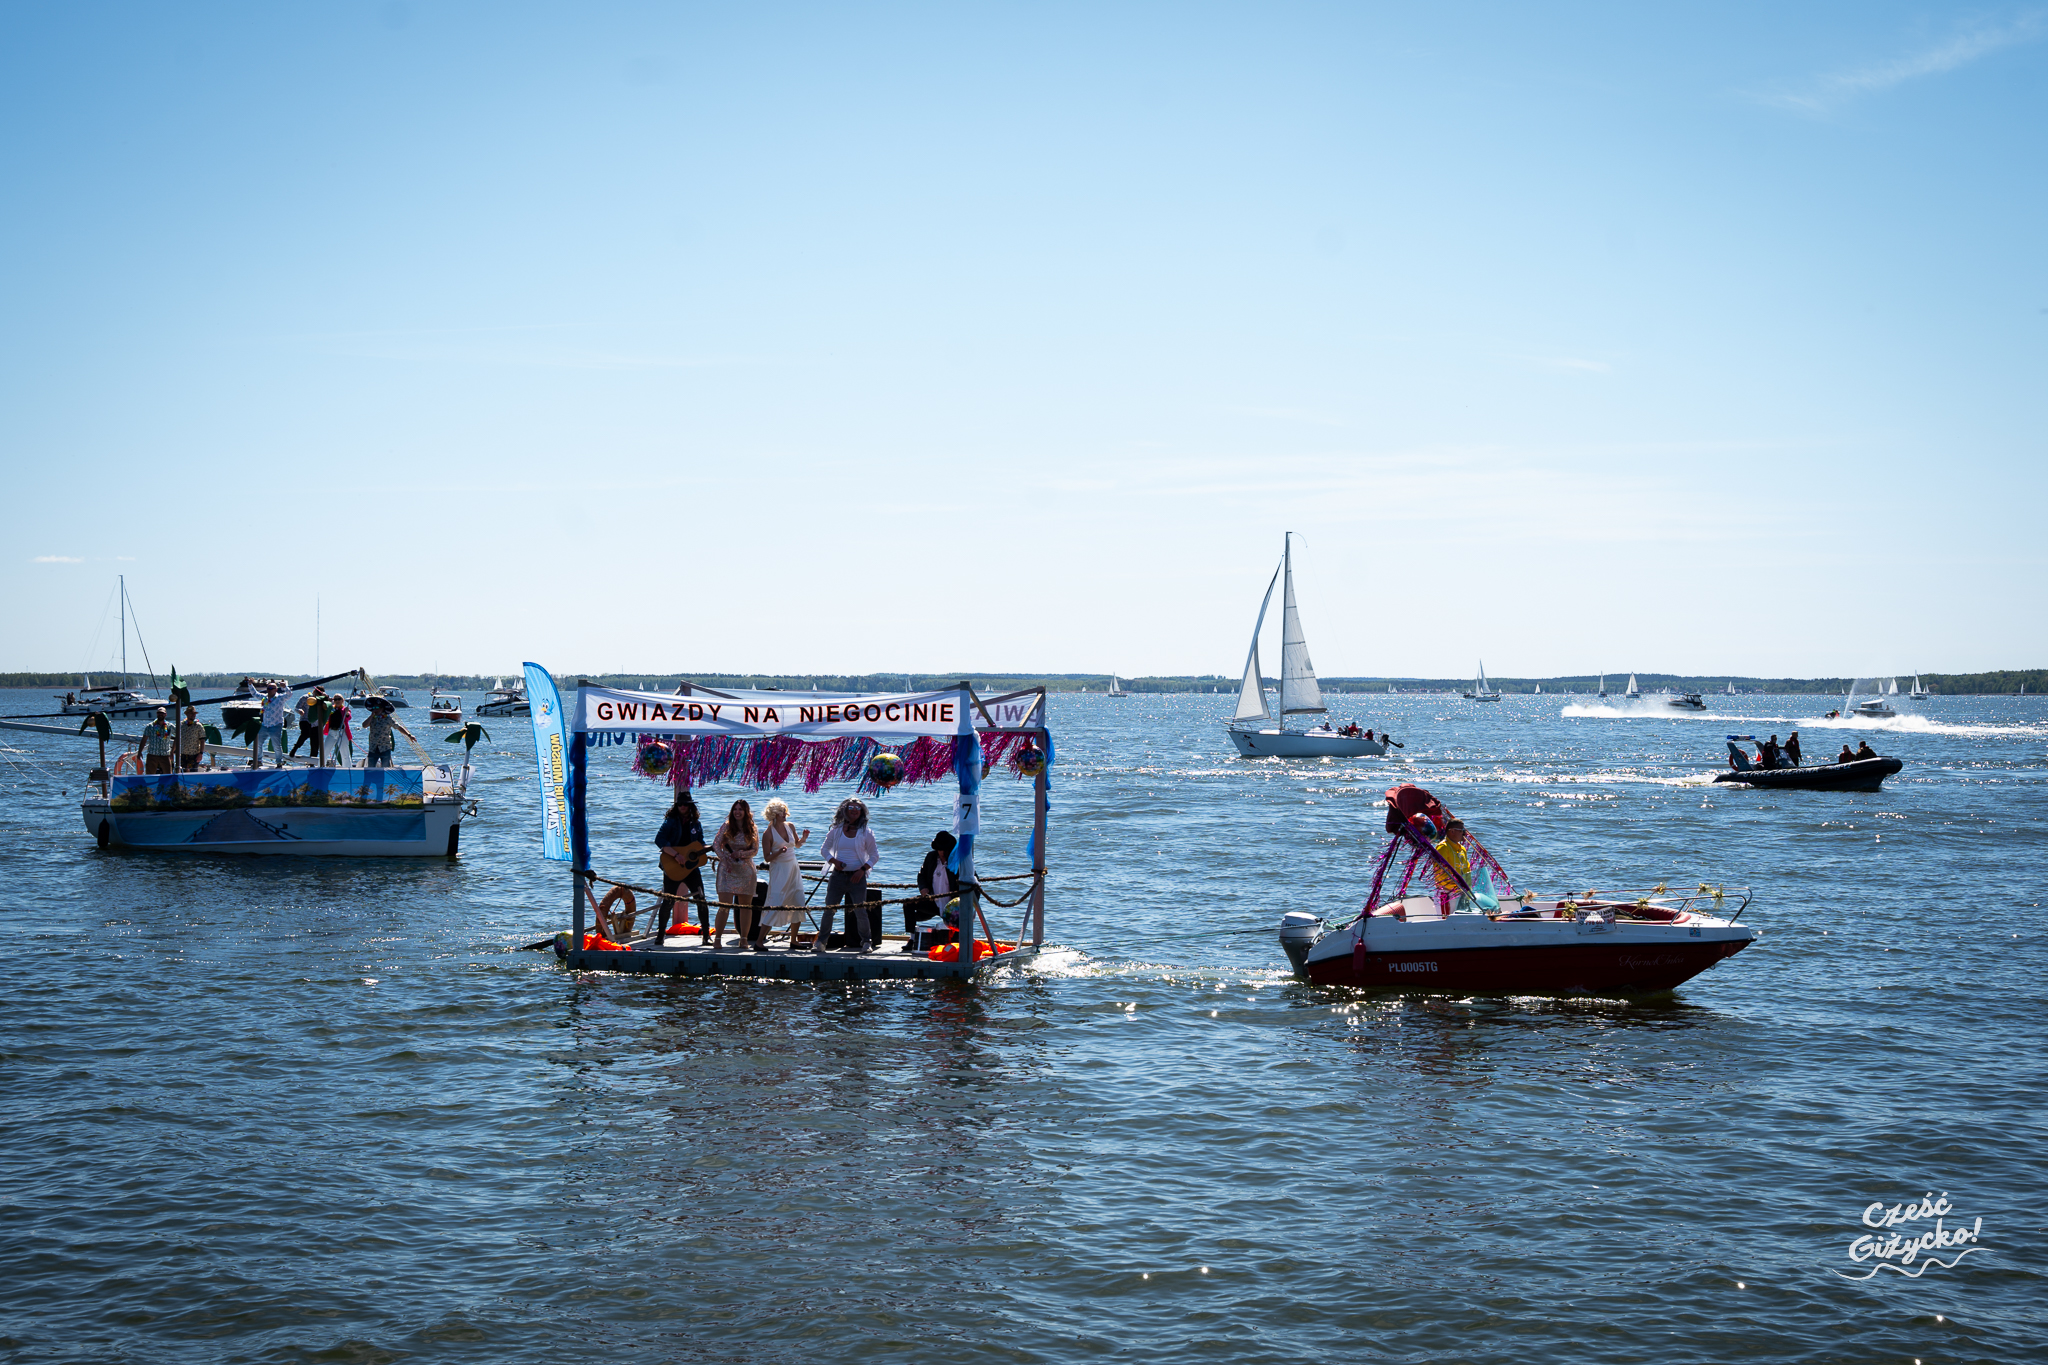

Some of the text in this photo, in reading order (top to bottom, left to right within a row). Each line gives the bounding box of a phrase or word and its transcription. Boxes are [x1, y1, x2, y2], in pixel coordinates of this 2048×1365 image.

[597, 702, 722, 721] GWIAZDY
[744, 706, 780, 723] NA
[799, 703, 955, 723] NIEGOCINIE
[440, 769, 447, 779] 3
[962, 803, 972, 820] 7
[1388, 961, 1438, 973] PL0005TG
